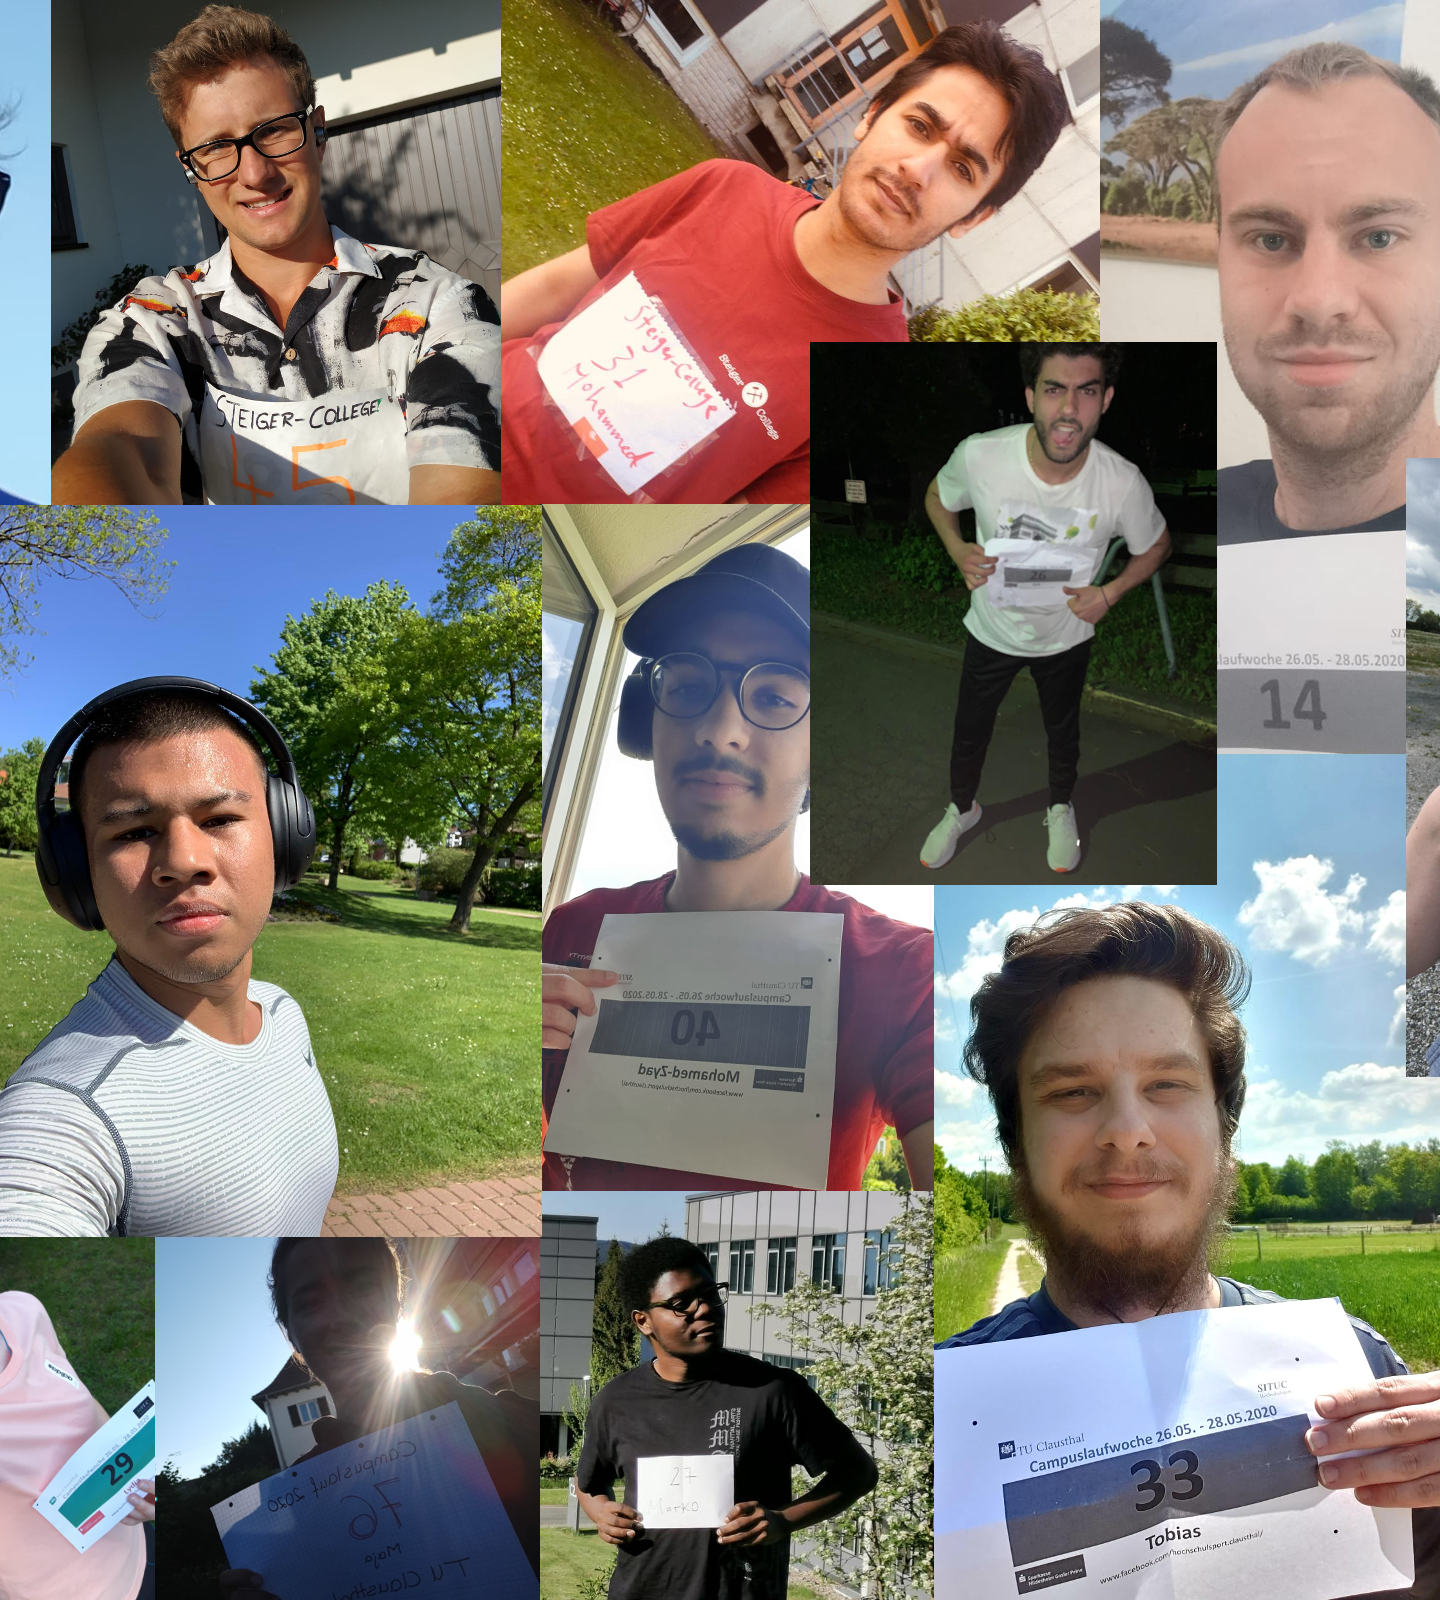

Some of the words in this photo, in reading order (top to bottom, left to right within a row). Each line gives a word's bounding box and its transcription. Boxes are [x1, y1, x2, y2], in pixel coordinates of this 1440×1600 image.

[591, 346, 647, 388] 31
[718, 353, 744, 386] Steiger
[756, 408, 780, 440] College
[231, 434, 355, 505] 45
[1030, 570, 1046, 580] 26
[1286, 654, 1324, 666] 26.05.
[1336, 654, 1406, 667] 28.05.2020
[1260, 679, 1326, 730] 14
[48, 1364, 73, 1382] adidas
[1257, 1379, 1288, 1394] SITUC
[1017, 1444, 1034, 1456] TU
[1036, 1433, 1085, 1452] Clausthal
[1030, 1434, 1154, 1474] Campuslaufwoche
[1156, 1422, 1196, 1443] 26.05.
[1207, 1404, 1278, 1430] 28.05.2020
[100, 1452, 134, 1486] 29
[670, 1466, 697, 1486] 27
[1130, 1450, 1204, 1512] 33
[1145, 1524, 1202, 1552] Tobias
